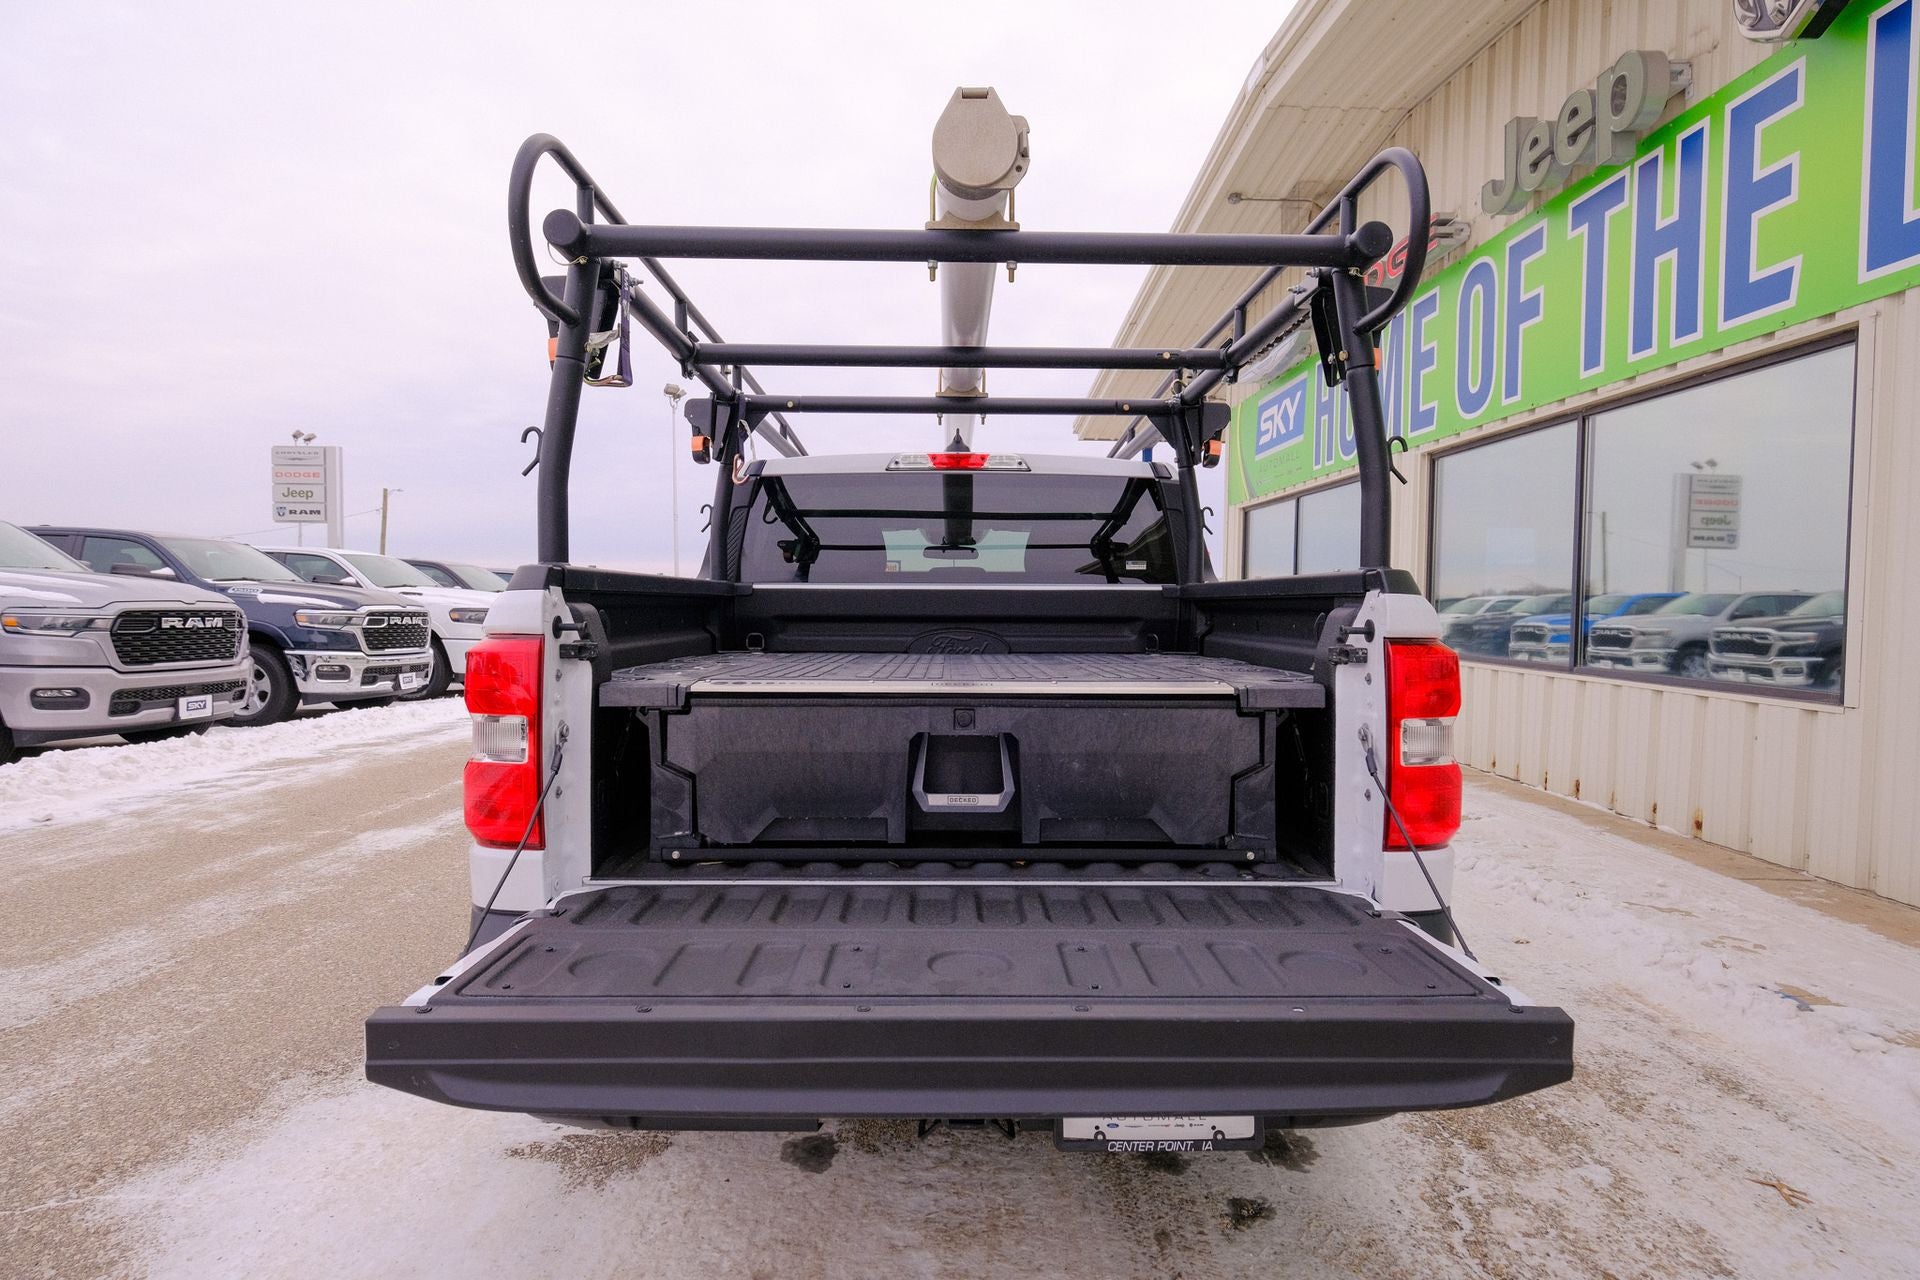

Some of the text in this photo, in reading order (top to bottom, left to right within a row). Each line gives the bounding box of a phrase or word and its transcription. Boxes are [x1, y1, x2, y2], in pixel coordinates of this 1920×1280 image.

[1481, 50, 1671, 215] Jeep
[1455, 218, 1548, 419] OF
[1567, 55, 1807, 380] THE
[1258, 390, 1302, 446] SKY
[282, 487, 314, 500] Jeep
[161, 617, 223, 629] RAM
[187, 701, 206, 710] SKY
[1107, 1141, 1213, 1152] CENTER POINT, IA
